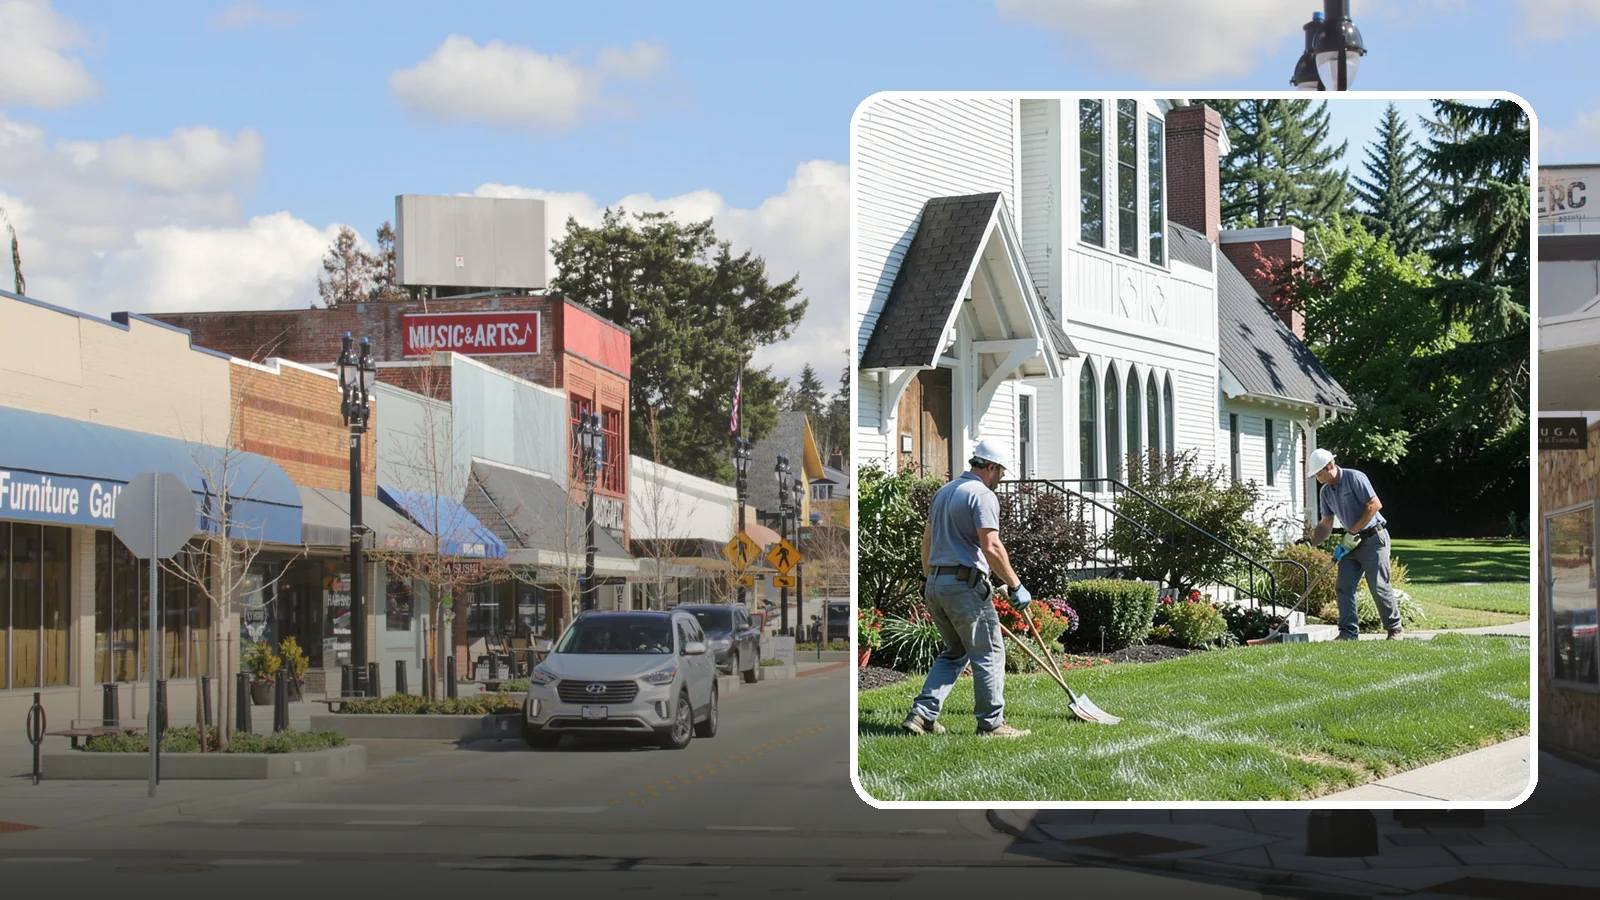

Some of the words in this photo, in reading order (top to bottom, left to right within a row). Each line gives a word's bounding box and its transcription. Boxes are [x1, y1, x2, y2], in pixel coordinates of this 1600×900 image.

[1540, 427, 1578, 437] UGA
[0, 471, 80, 515] Furniture
[453, 563, 480, 575] SUSHI
